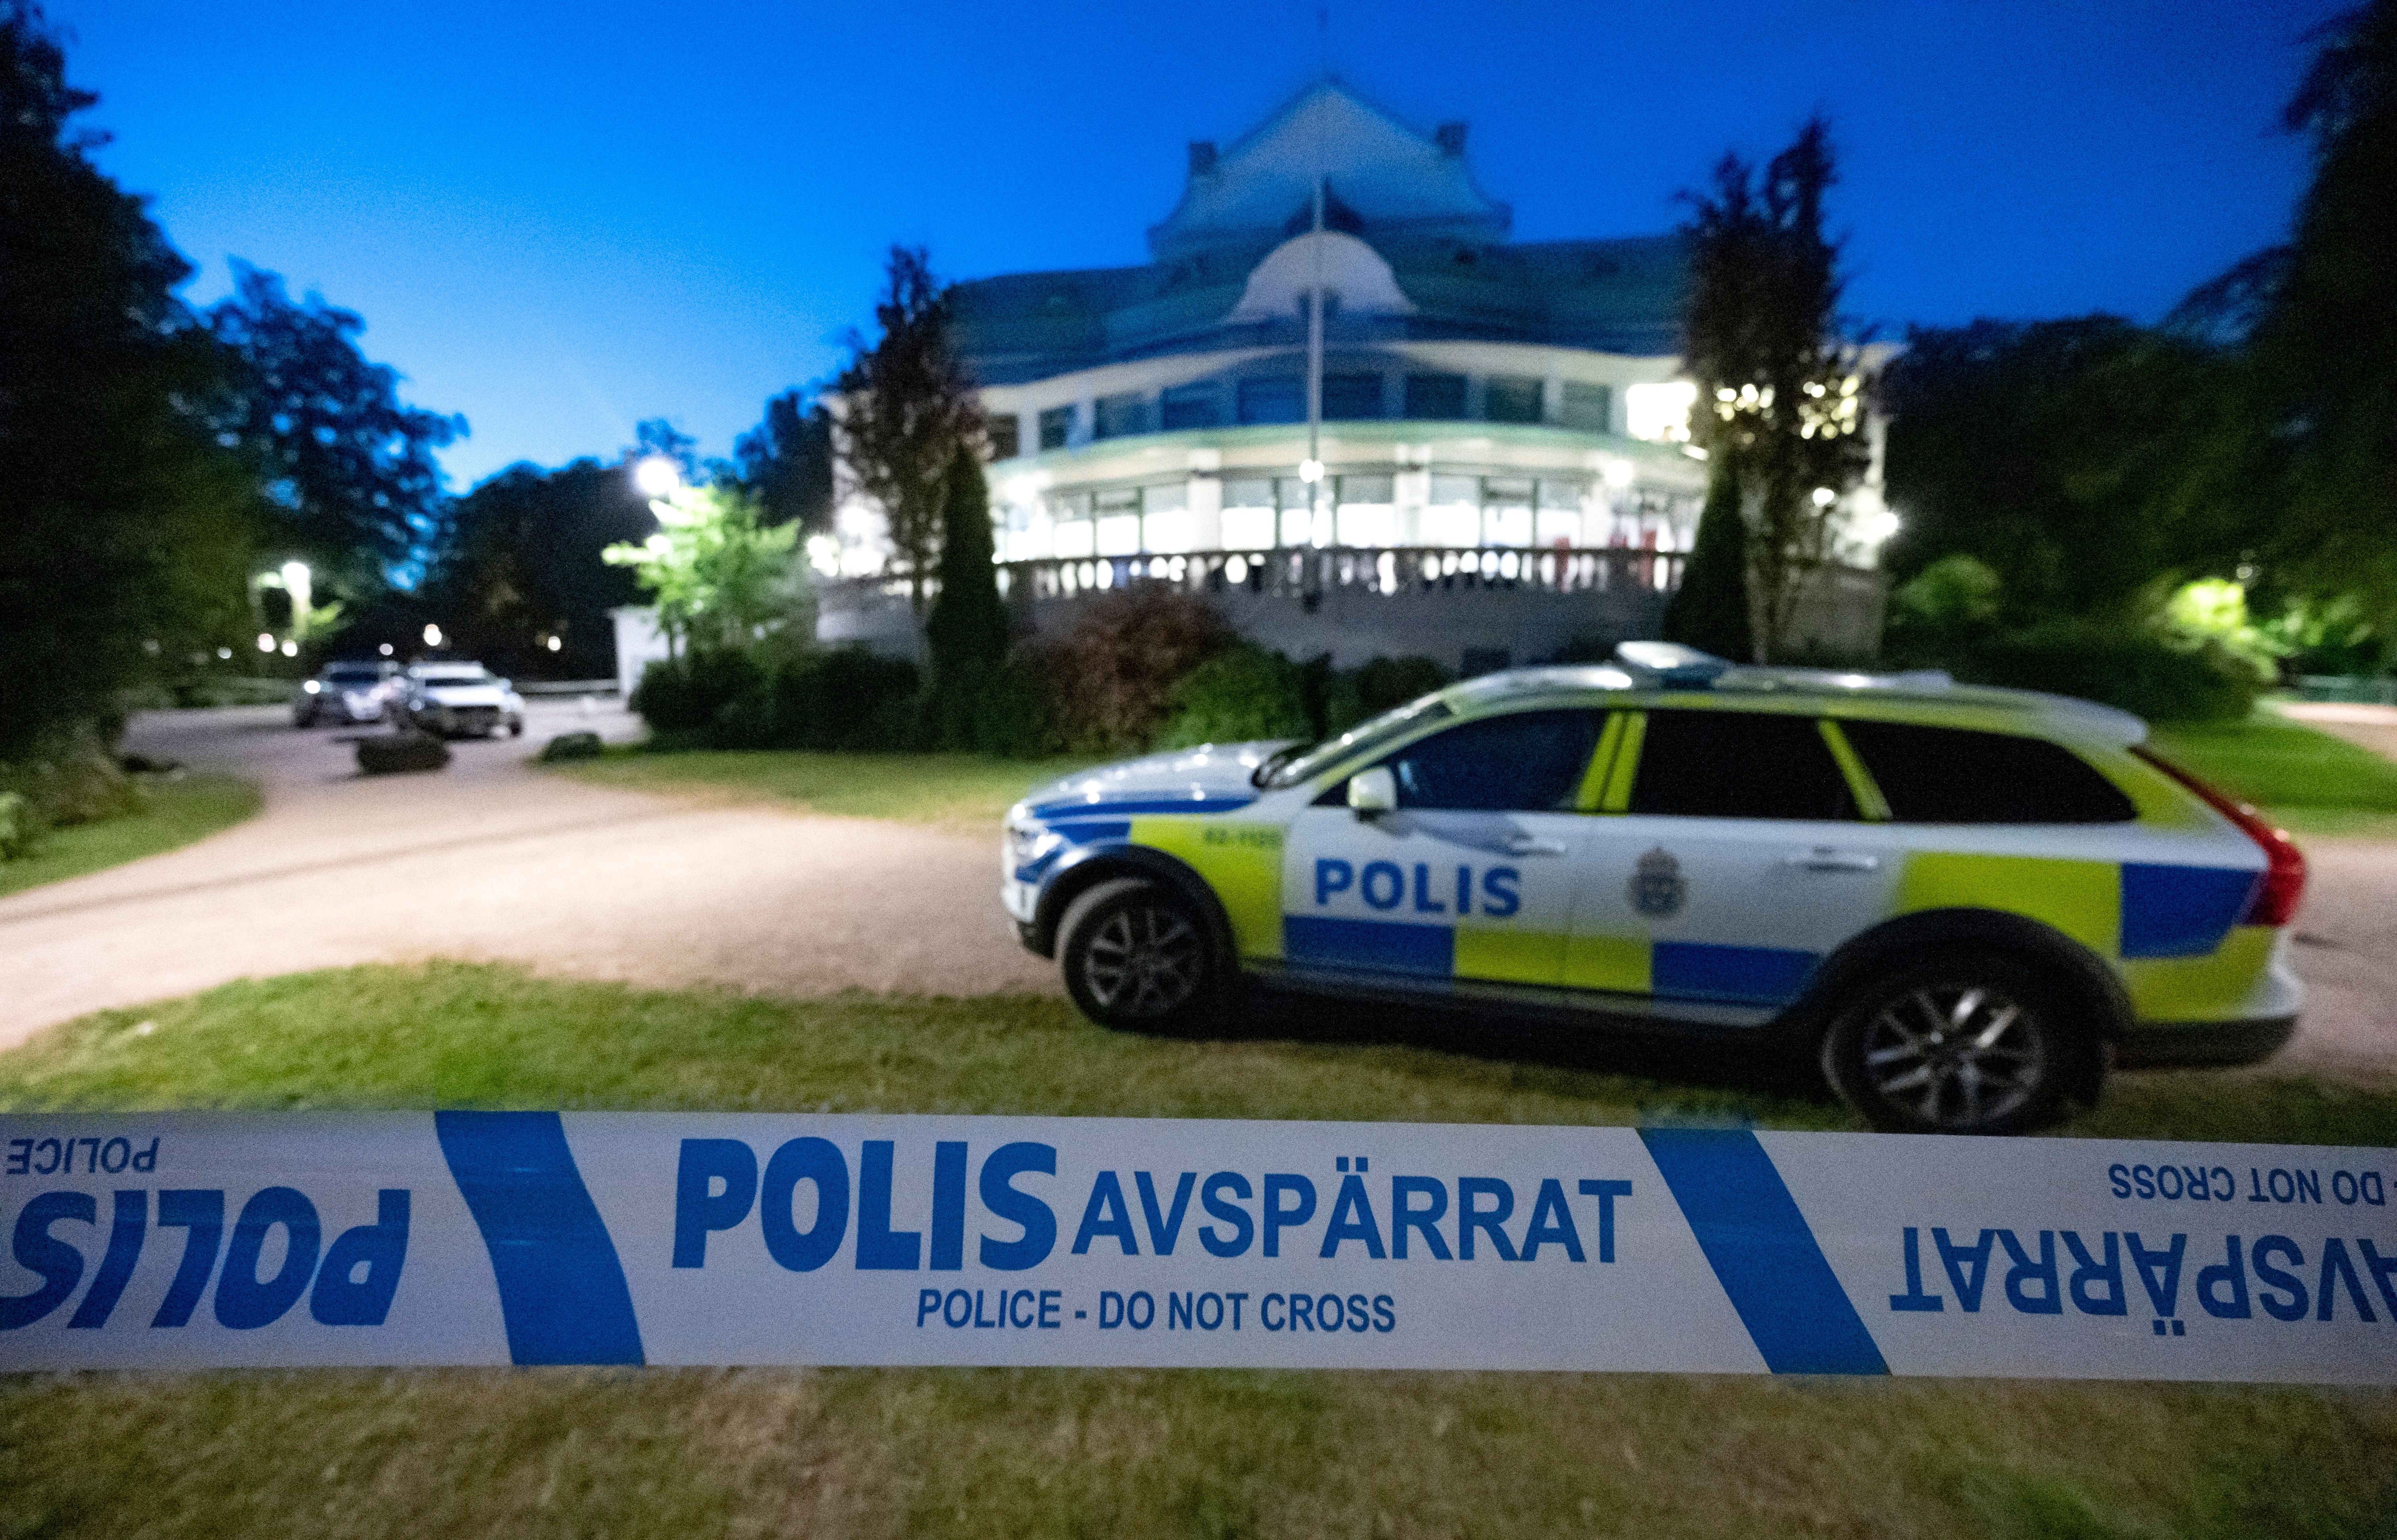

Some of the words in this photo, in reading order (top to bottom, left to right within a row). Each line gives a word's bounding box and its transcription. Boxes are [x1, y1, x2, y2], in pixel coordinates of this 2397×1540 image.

[1315, 858, 1520, 918] POLIS
[7, 1137, 159, 1175] POLICE
[2108, 1164, 2235, 1202] CROSS
[2248, 1168, 2322, 1204] NOT
[2332, 1170, 2385, 1206] DO
[672, 1137, 1056, 1272] POLIS
[1072, 1157, 1632, 1263] AVSPÄRRAT
[0, 1187, 409, 1332] POLIS
[917, 1289, 1061, 1329] POLICE
[1099, 1291, 1155, 1330] DO
[1169, 1292, 1248, 1330] NOT
[1261, 1293, 1395, 1333] CROSS
